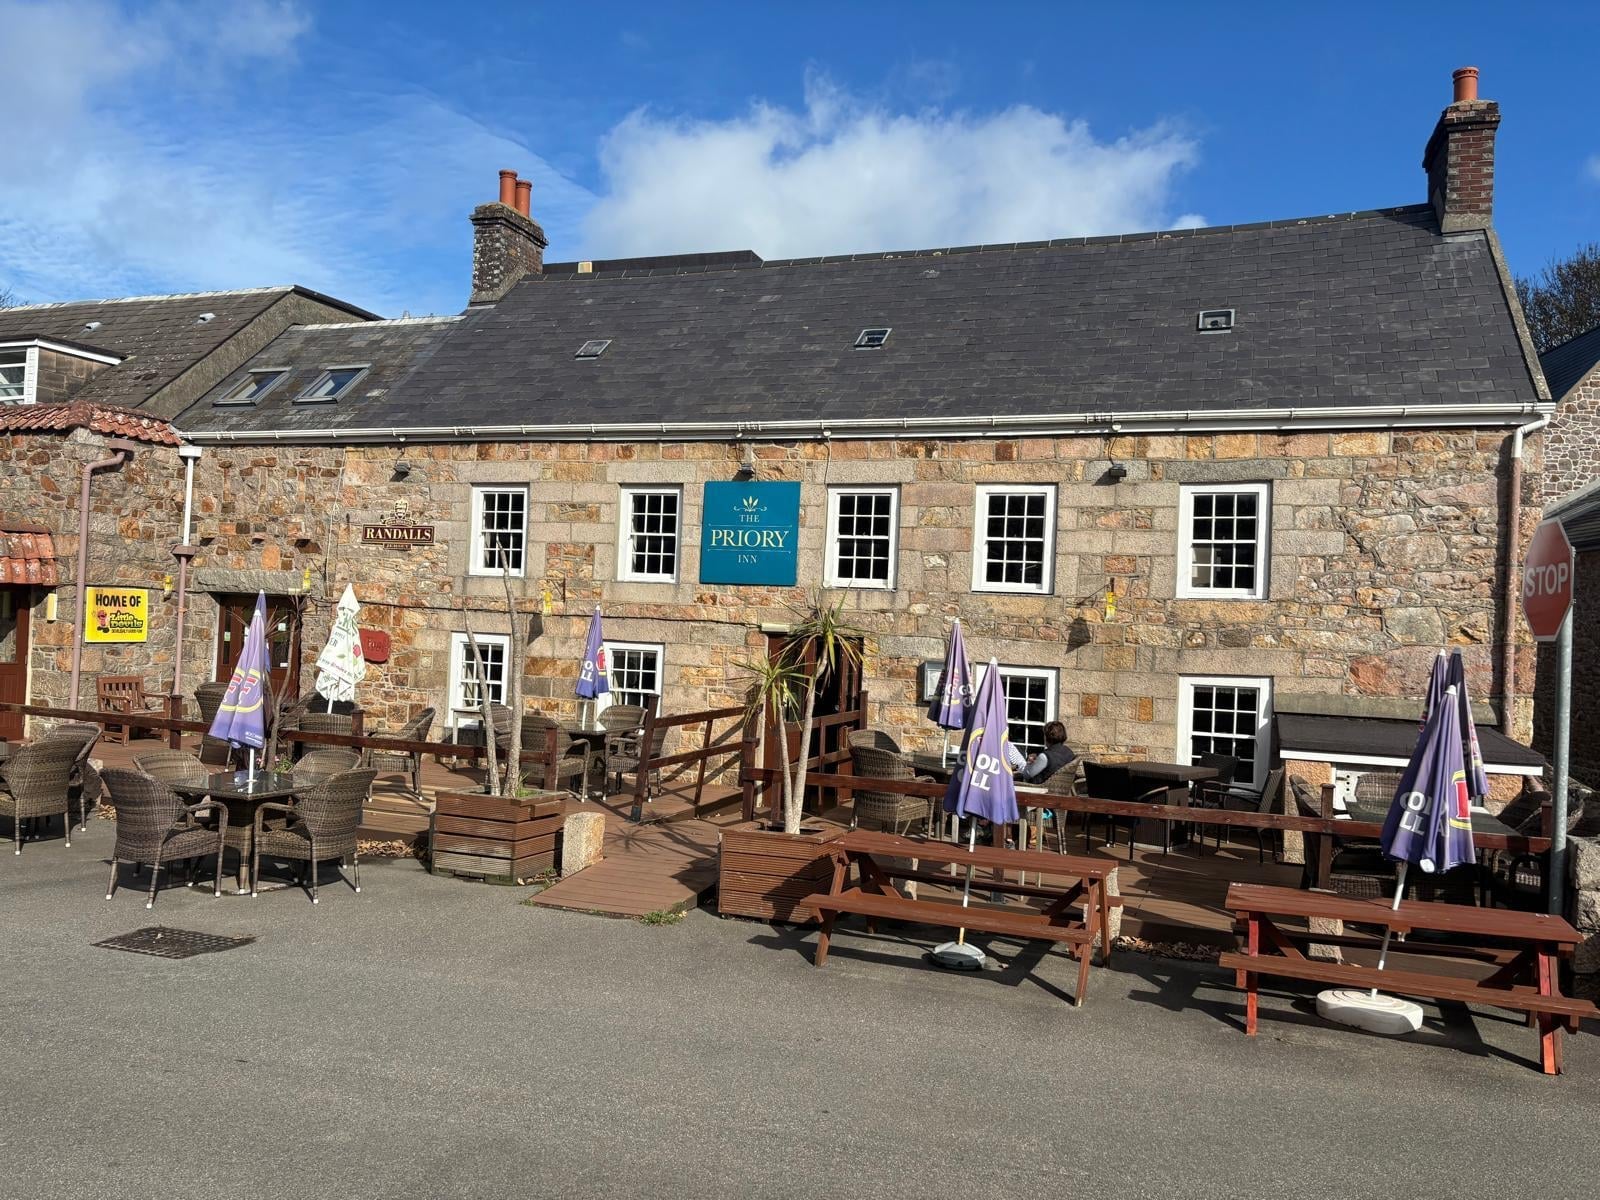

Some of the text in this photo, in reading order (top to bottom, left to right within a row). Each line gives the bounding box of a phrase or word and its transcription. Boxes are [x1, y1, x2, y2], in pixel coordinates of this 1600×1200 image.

[739, 514, 760, 523] THE
[366, 528, 431, 540] RANDALLS
[710, 529, 789, 548] PRIORY
[738, 554, 757, 564] INN
[1525, 562, 1569, 597] STOP
[96, 594, 142, 607] HOME OF
